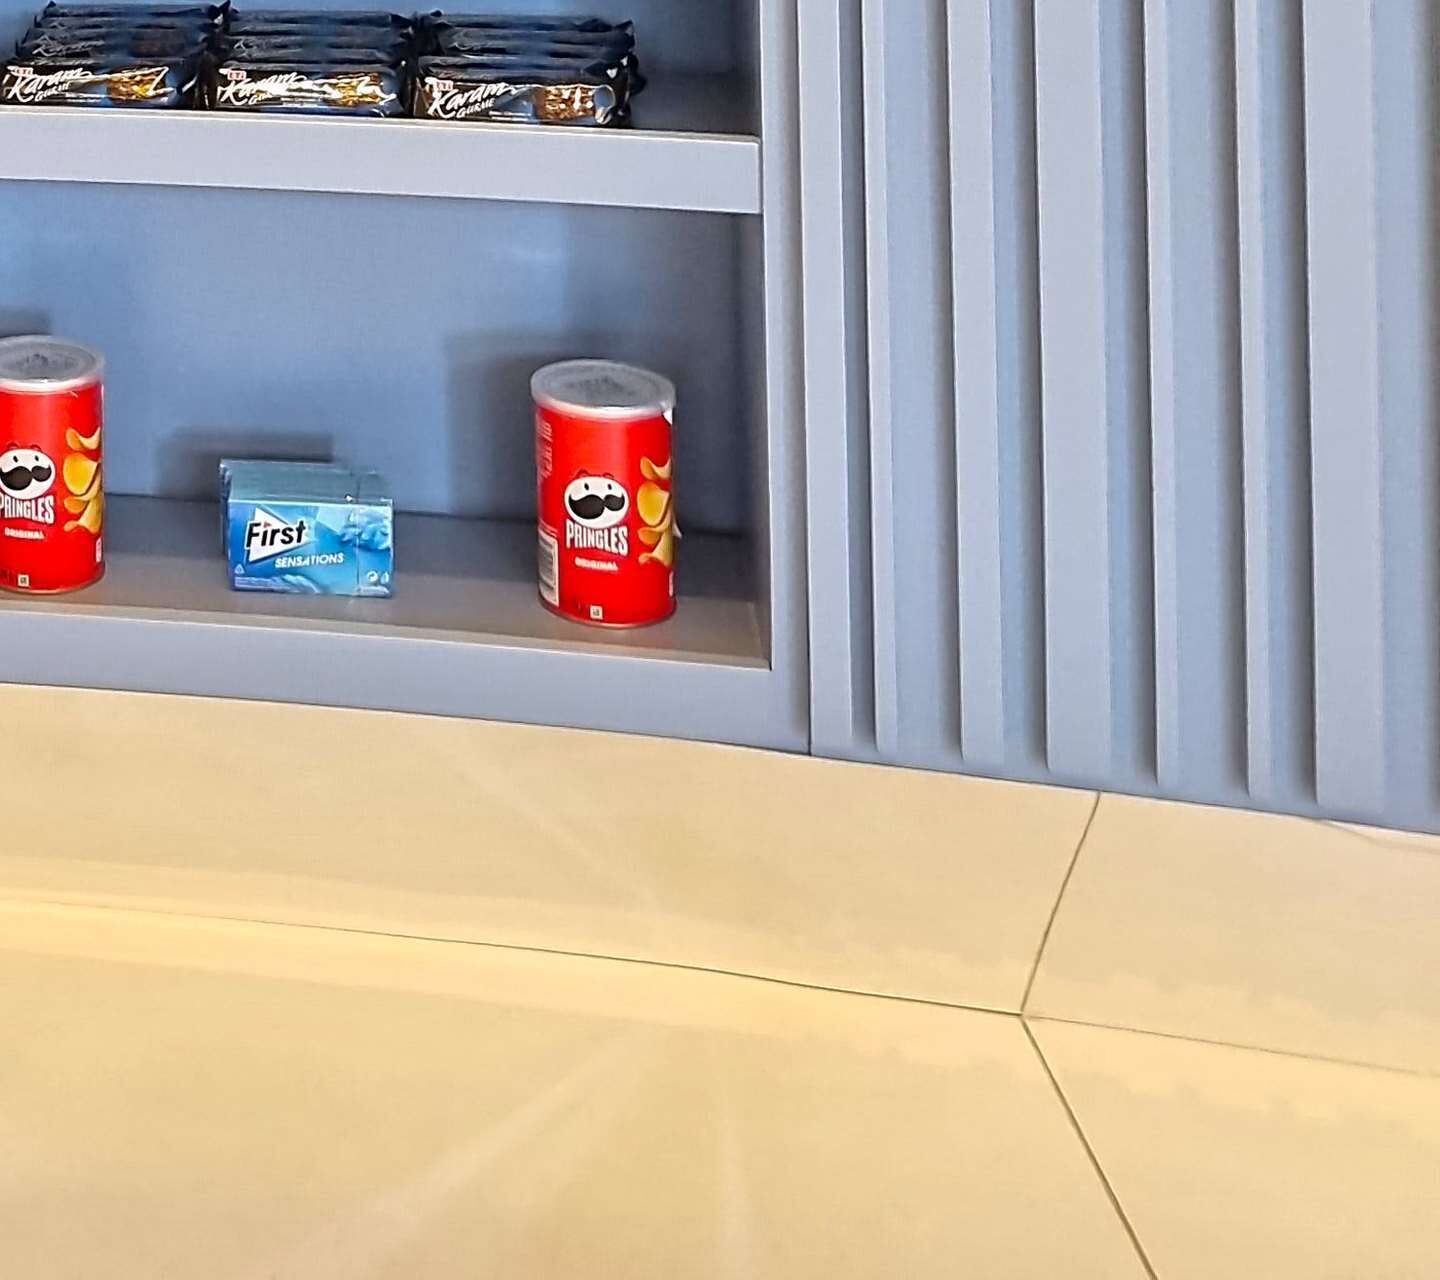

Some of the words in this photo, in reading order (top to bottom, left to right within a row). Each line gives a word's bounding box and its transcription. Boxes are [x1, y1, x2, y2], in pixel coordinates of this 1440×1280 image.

[246, 520, 306, 548] First
[565, 519, 628, 557] PRINGLES
[275, 552, 345, 568] SENSATIONS
